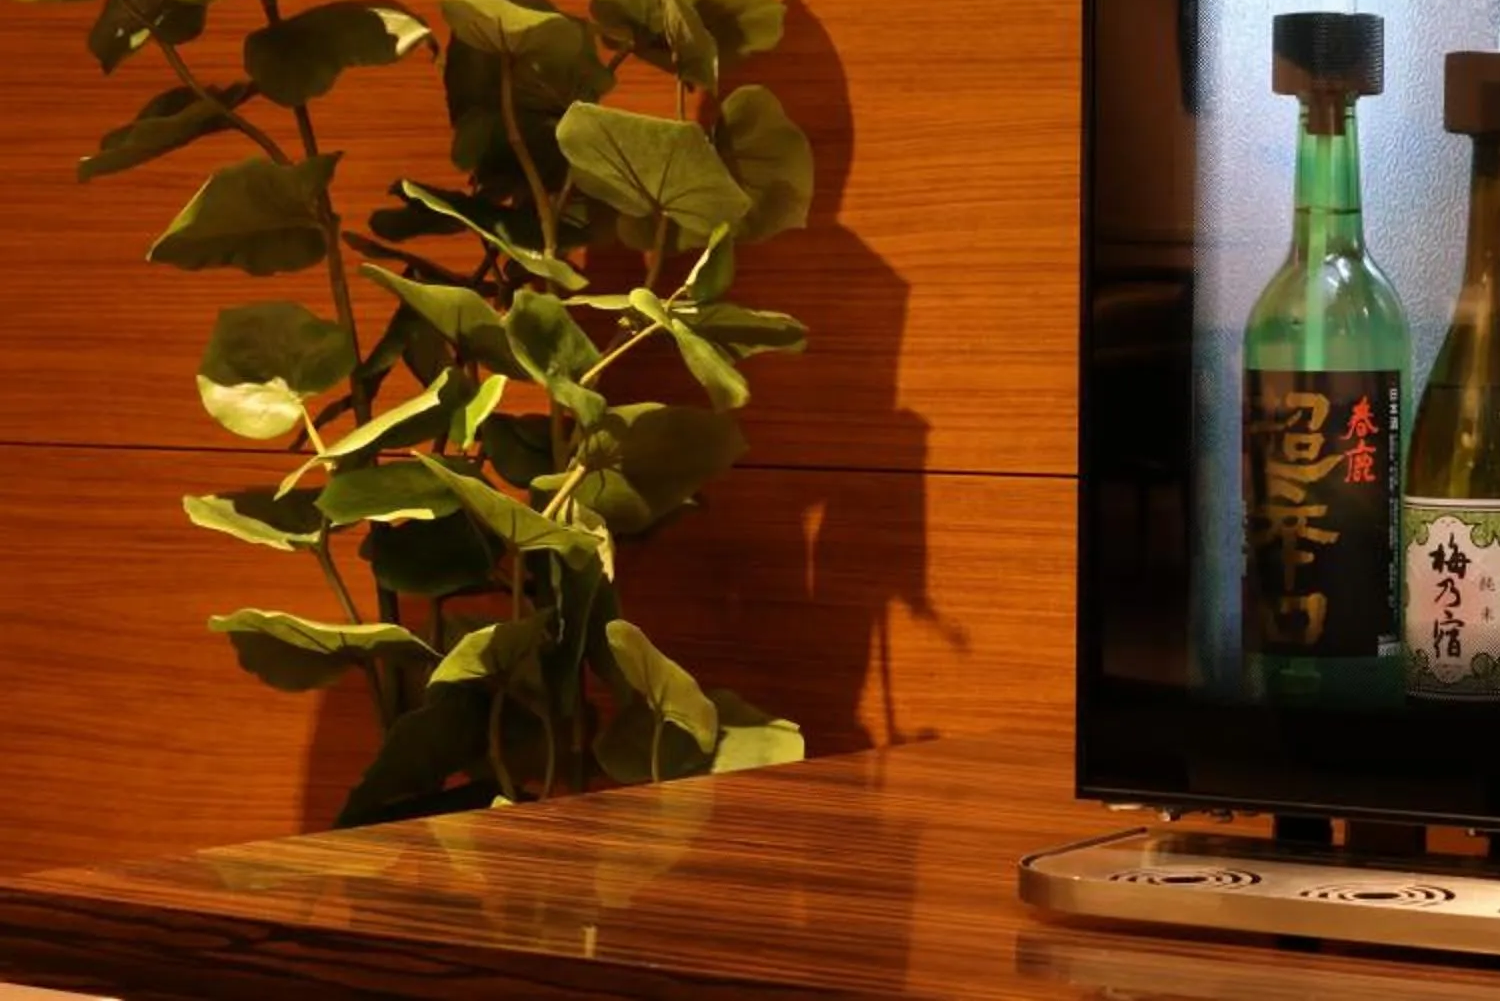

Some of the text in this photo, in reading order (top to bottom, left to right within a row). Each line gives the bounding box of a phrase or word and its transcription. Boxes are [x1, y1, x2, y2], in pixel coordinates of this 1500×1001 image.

[1341, 395, 1379, 483] 春鹿
[1428, 531, 1472, 659] 梅乃宿
